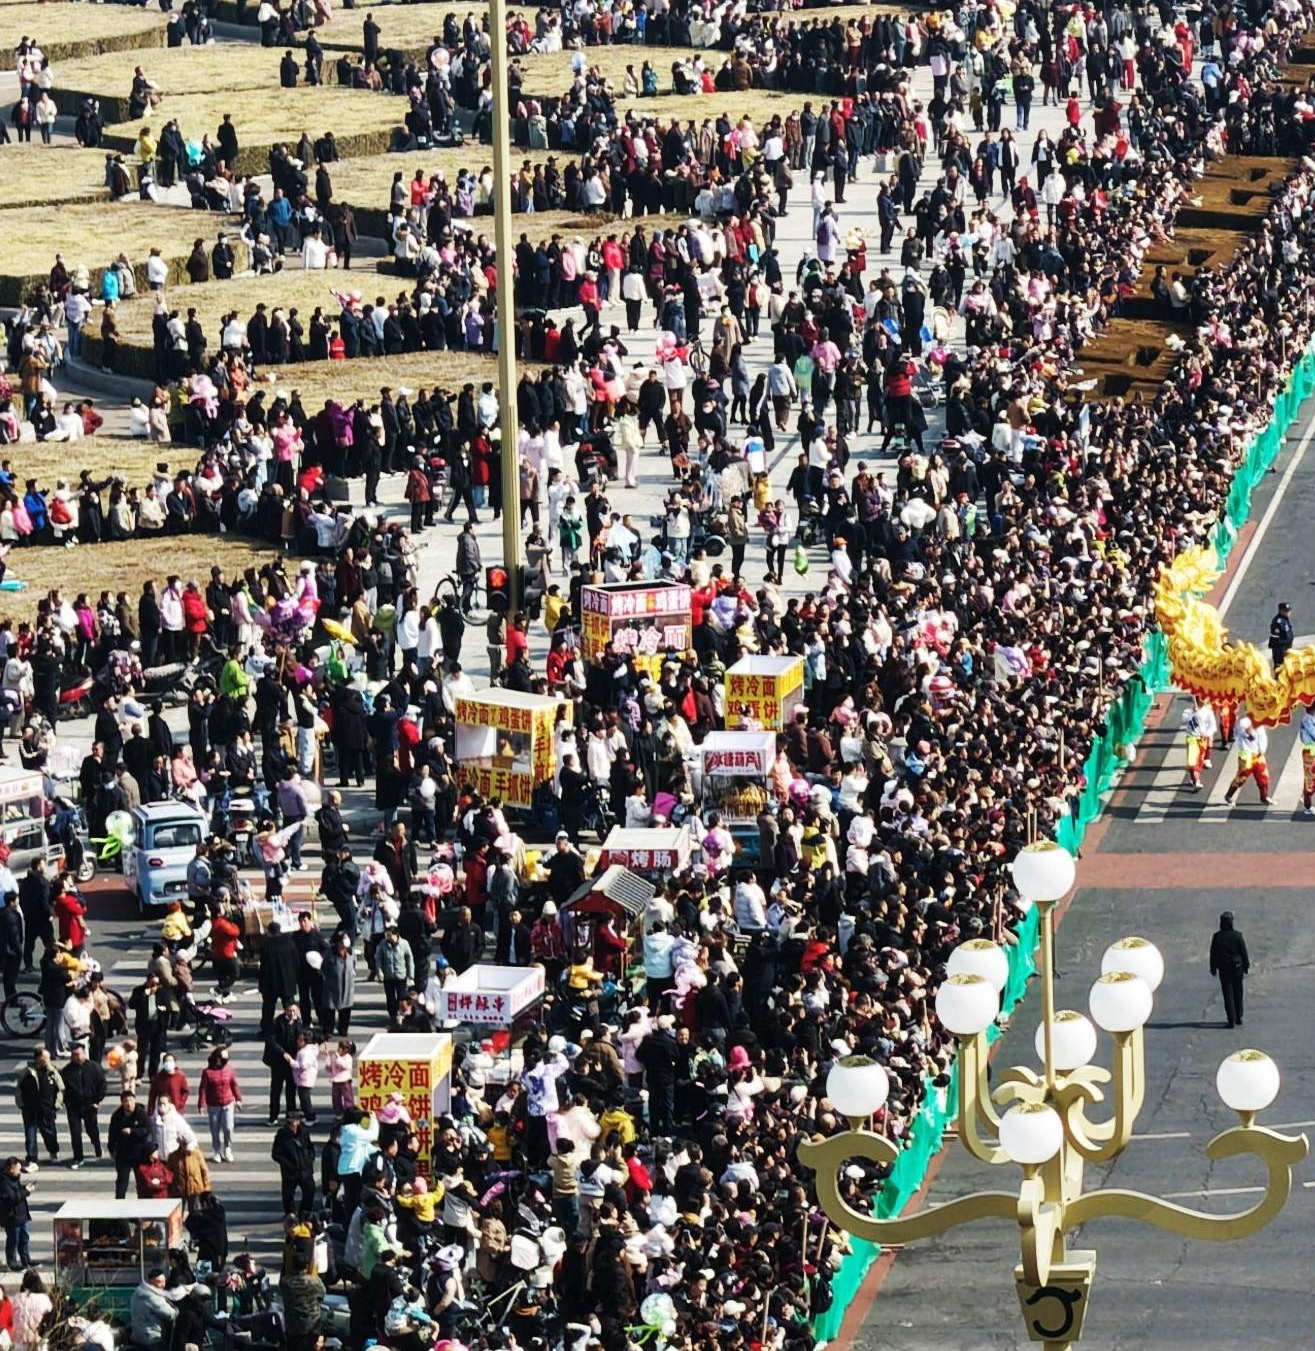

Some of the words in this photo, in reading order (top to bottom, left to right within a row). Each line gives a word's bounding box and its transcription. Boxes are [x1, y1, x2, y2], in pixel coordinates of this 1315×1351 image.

[611, 592, 647, 615] 烤冷面
[729, 675, 776, 697] 烤冷面
[457, 699, 489, 725] 烤冷面
[499, 706, 532, 733] 鸡蛋饼
[705, 751, 761, 773] 冰糖葫芦
[631, 850, 671, 867] 烤肠
[360, 1061, 430, 1089] 烤冷面
[360, 1094, 431, 1123] 鸡饼
